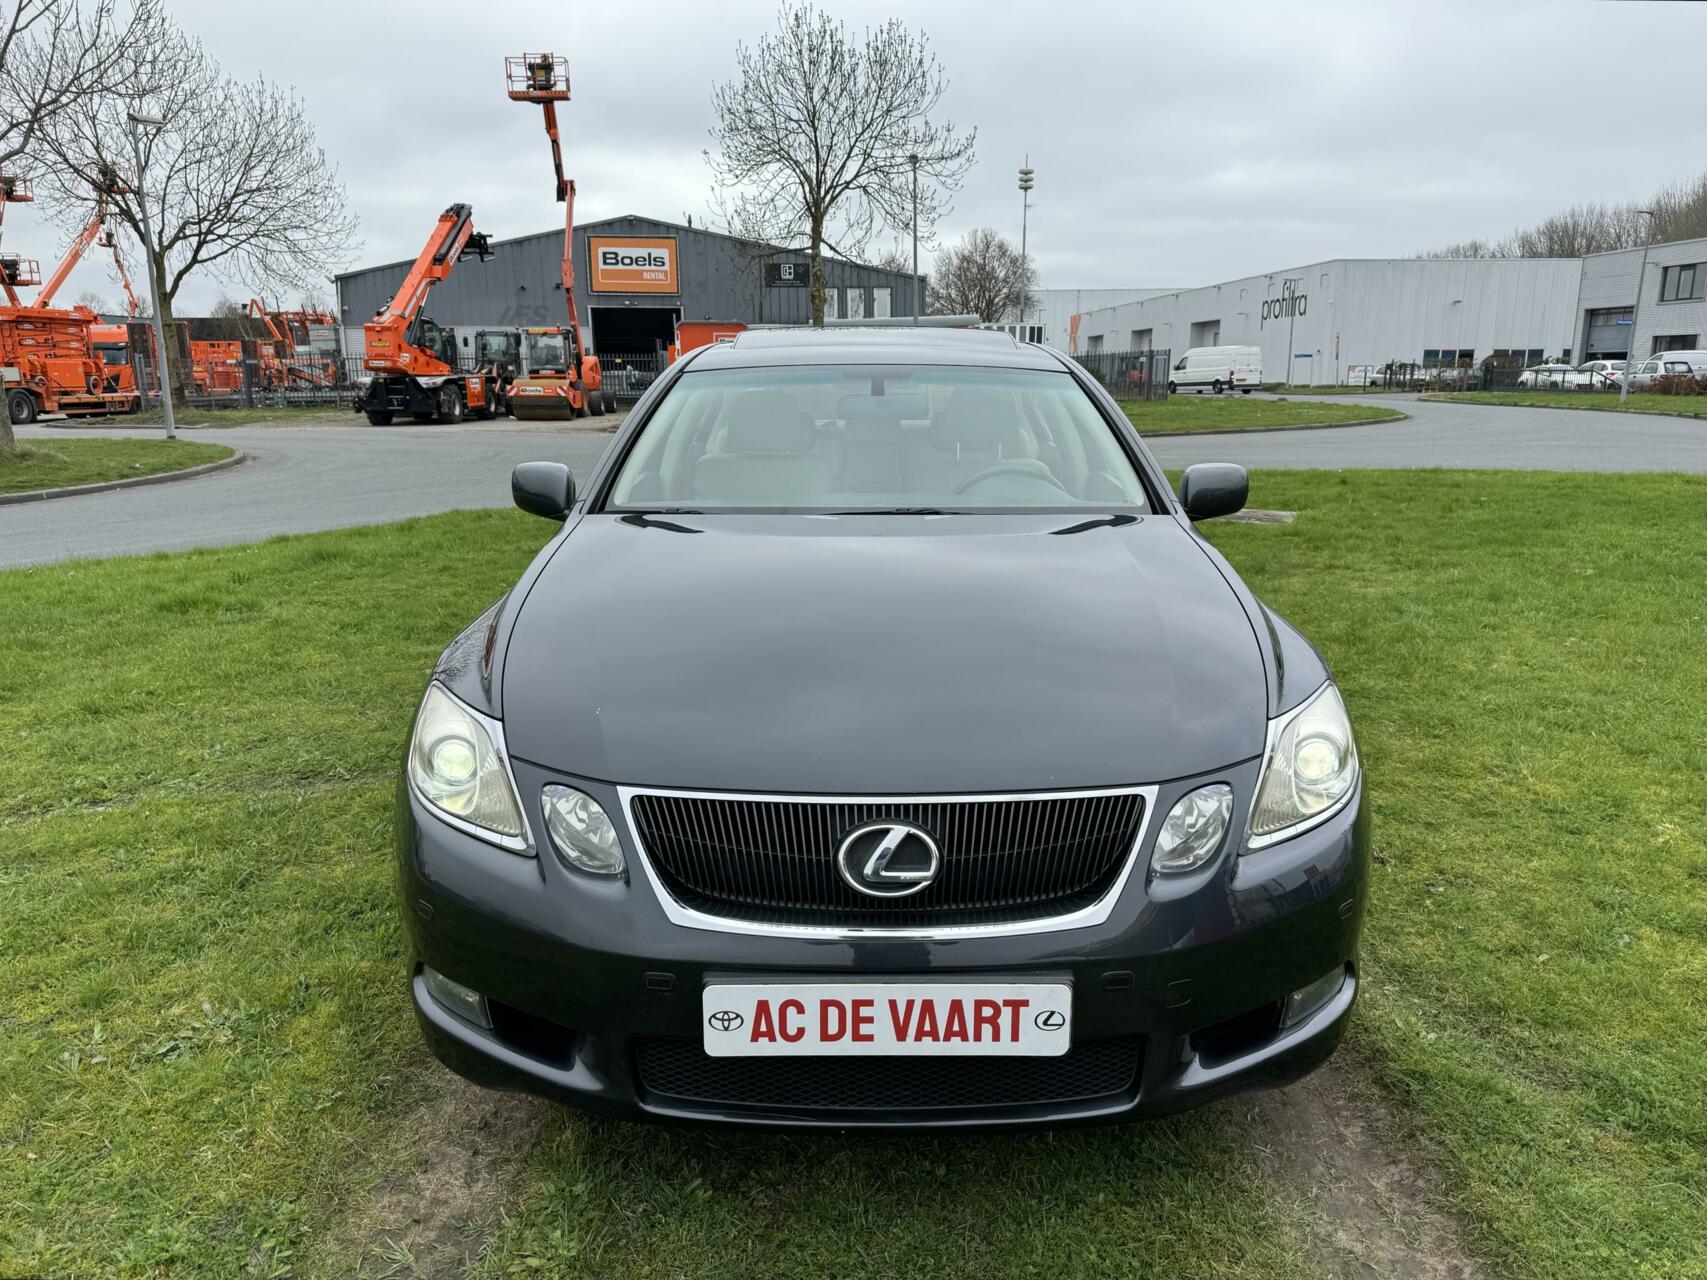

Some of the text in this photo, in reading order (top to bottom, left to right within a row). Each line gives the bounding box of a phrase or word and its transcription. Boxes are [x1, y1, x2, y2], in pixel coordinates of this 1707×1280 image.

[602, 251, 666, 267] Boels
[642, 271, 667, 280] RENTAL
[1261, 280, 1308, 331] profiltra
[750, 998, 1030, 1043] AC DE VAART
